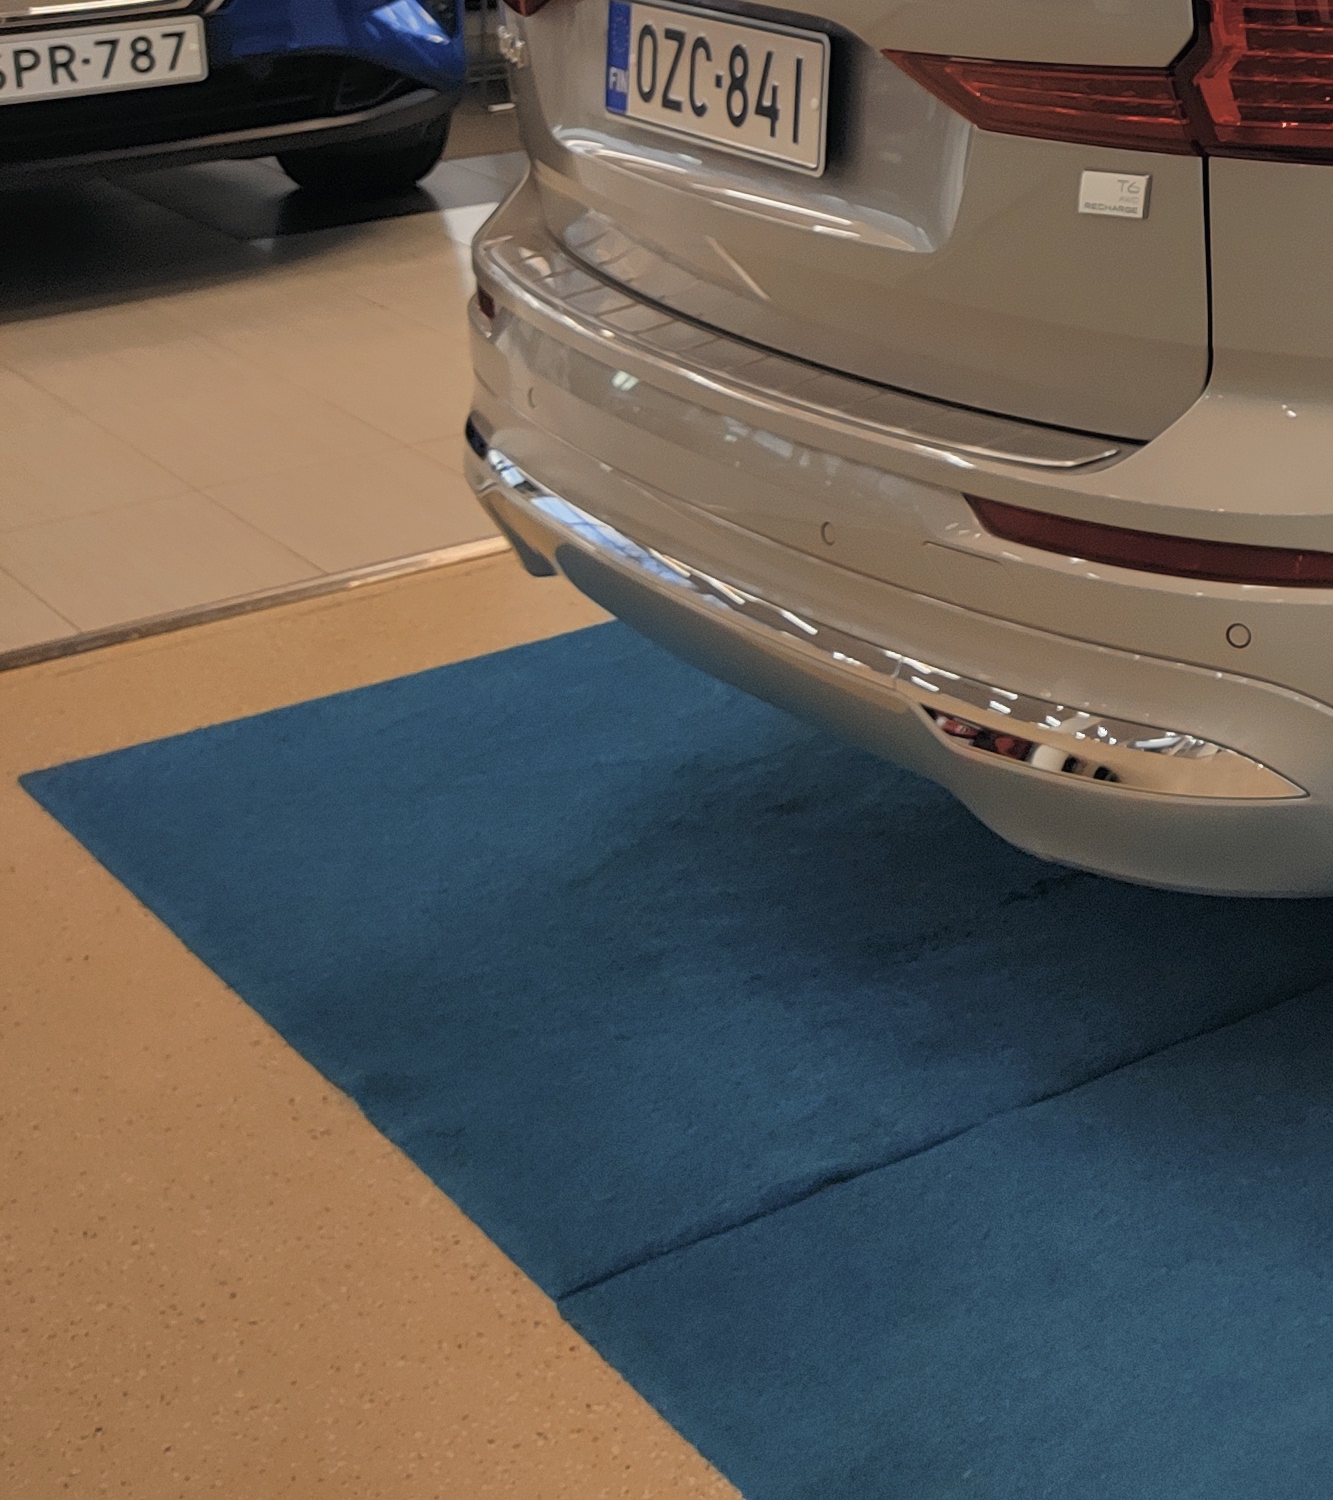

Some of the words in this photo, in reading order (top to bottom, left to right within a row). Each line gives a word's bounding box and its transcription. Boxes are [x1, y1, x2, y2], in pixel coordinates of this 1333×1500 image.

[0, 31, 187, 90] PR-787
[636, 23, 804, 145] OZC-841
[1117, 179, 1141, 194] T6
[1084, 202, 1139, 214] RECHARGE
